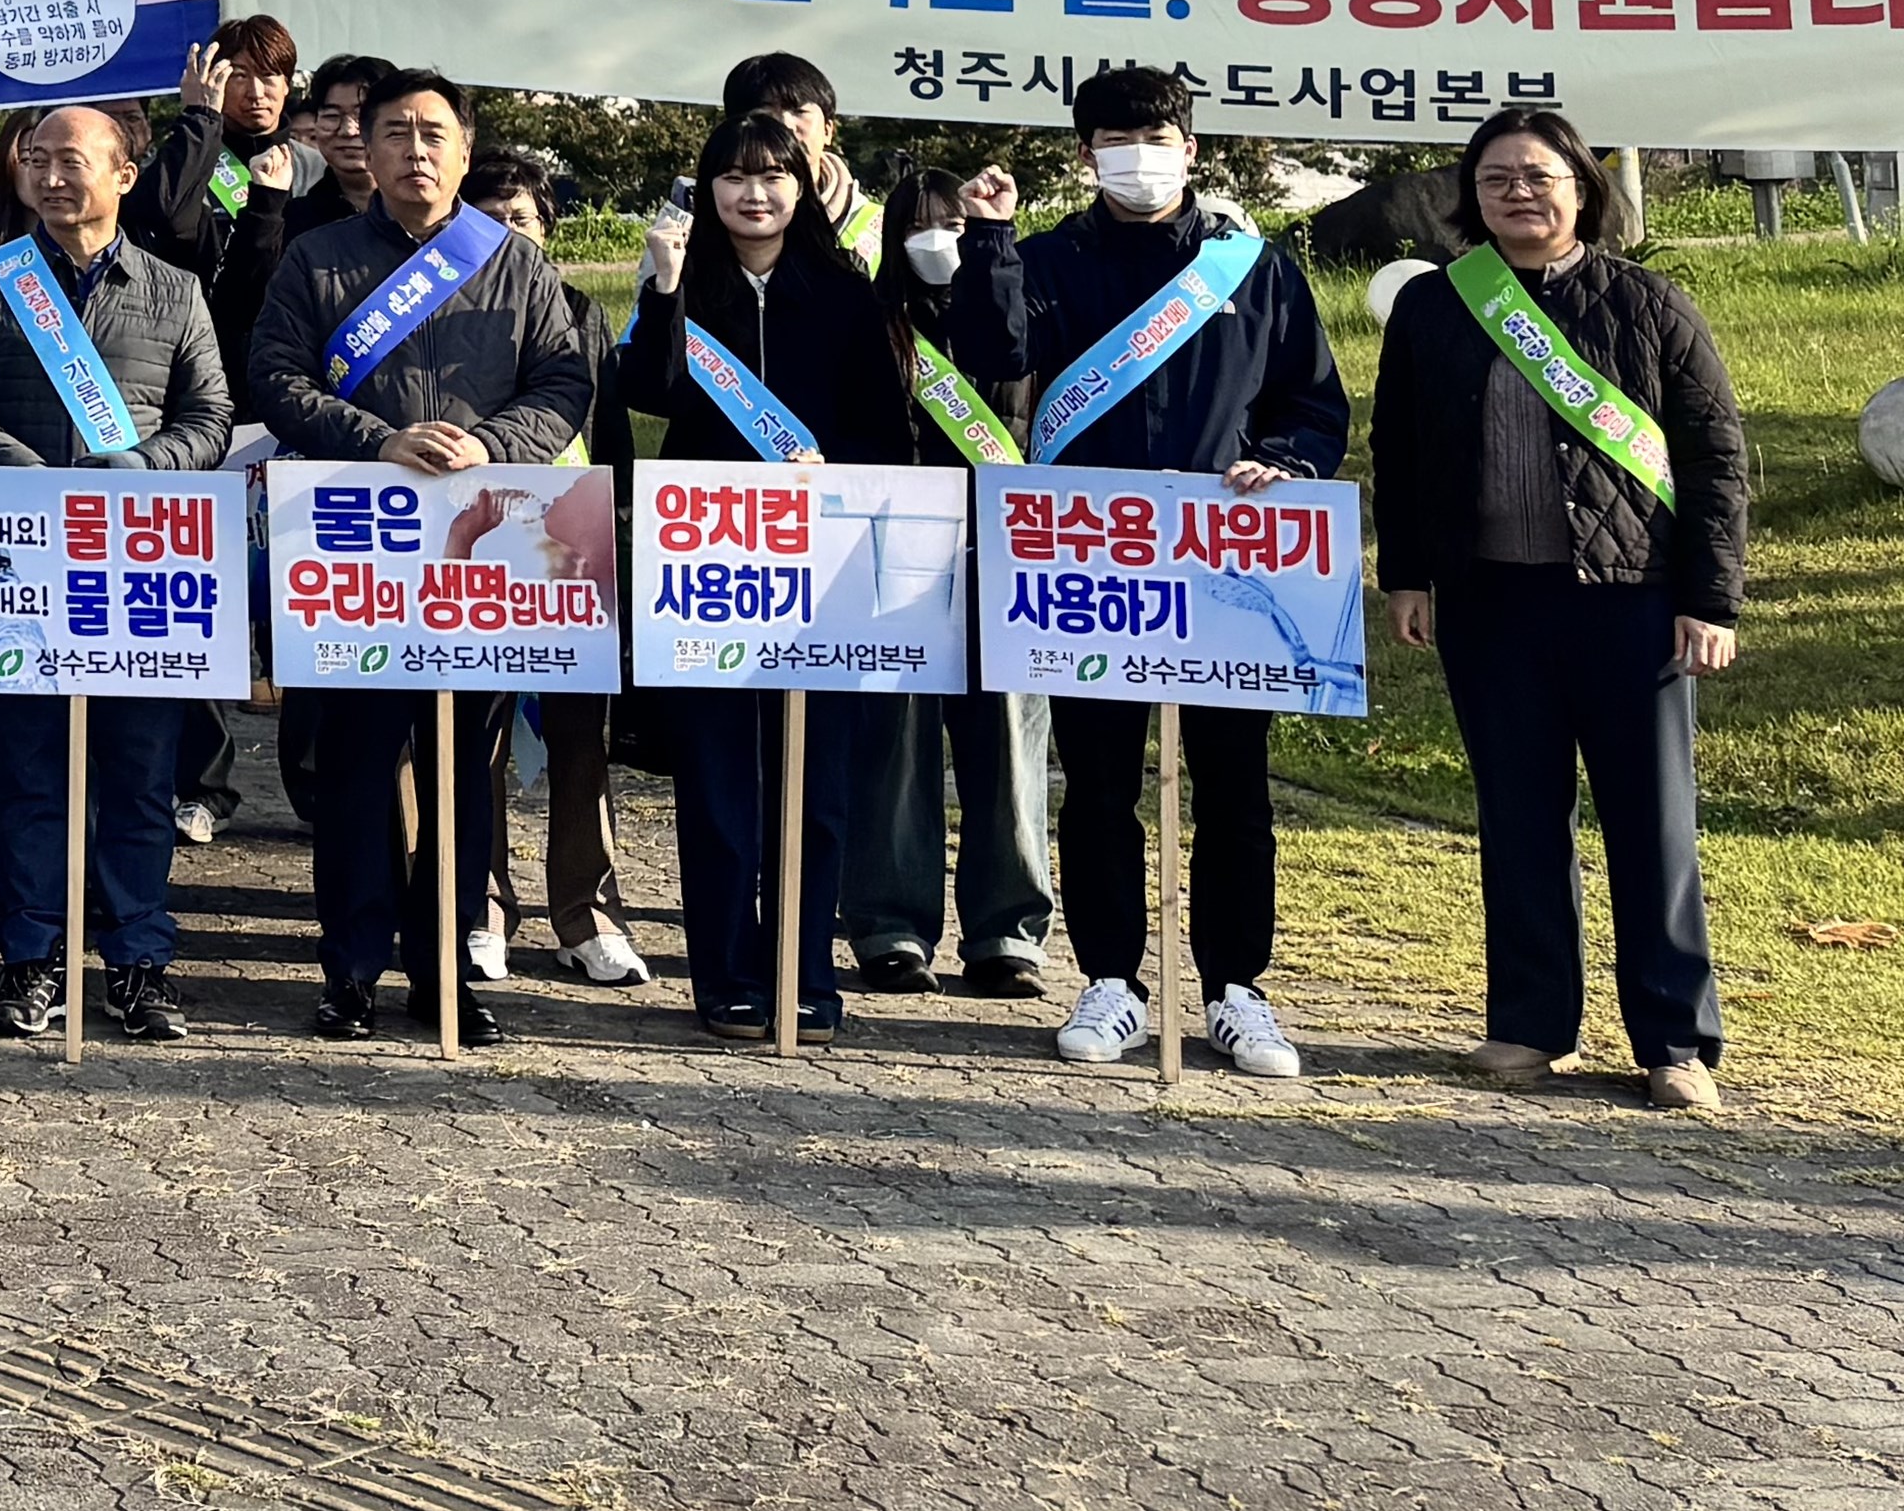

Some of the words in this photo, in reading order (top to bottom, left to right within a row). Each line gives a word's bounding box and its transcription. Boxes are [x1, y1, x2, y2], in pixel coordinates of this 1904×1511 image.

[38, 22, 86, 42] 약하게
[47, 0, 78, 19] 외출
[4, 51, 36, 69] 동파
[44, 42, 105, 67] 방지하기
[15, 271, 68, 353] 물절약!
[62, 357, 123, 446] 가뭄극복
[1111, 299, 1190, 369] 물절약!
[63, 493, 109, 562] 물
[123, 496, 214, 564] 낭비
[312, 485, 422, 552] 물은
[655, 483, 811, 556] 양치컵
[1004, 491, 1158, 564] 절수용
[1173, 501, 1331, 576] 샤워기
[66, 569, 109, 637] 물
[122, 568, 219, 641] 절약
[287, 561, 405, 627] 우리의
[417, 562, 609, 631] 생명입니다.
[654, 563, 812, 625] 사용하기
[1007, 572, 1188, 639] 사용하기
[35, 650, 211, 680] 상수도사업본부
[401, 645, 578, 677] 상수도사업본부
[756, 642, 928, 673] 상수도사업본부
[1120, 655, 1320, 694] 상수도사업본부
